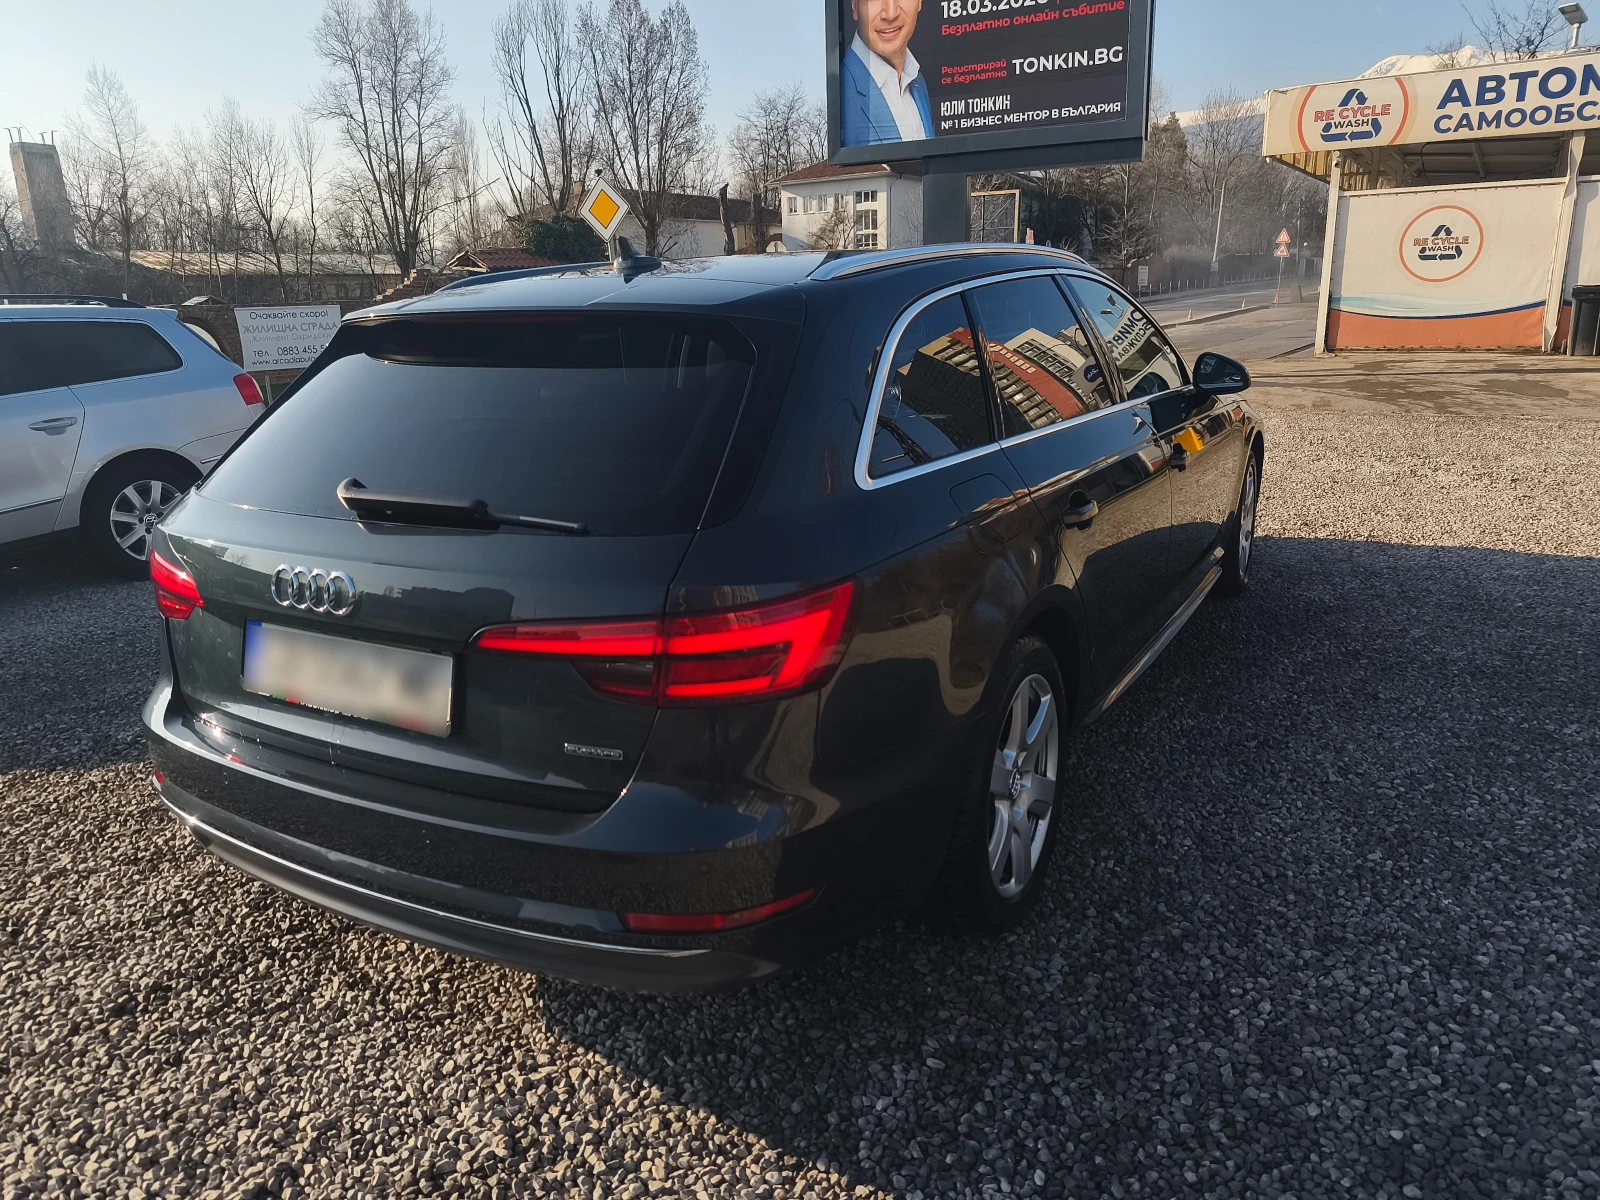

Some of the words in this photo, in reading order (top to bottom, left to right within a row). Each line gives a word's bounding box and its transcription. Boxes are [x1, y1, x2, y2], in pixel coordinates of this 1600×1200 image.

[941, 18, 1011, 36] Безплатно
[1013, 8, 1059, 25] онлайн
[1062, 0, 1125, 18] събитие
[941, 59, 1007, 75] Регистрирай
[1012, 46, 1123, 75] TONKIN.BG
[941, 76, 952, 85] се
[954, 70, 1007, 84] безплатно
[940, 100, 965, 117] ЮЛИ
[967, 95, 1011, 114] ТОНКИН
[1314, 109, 1335, 122] RE
[1339, 104, 1391, 120] CYCLE
[961, 114, 1002, 128] БИЗНЕС
[1004, 109, 1050, 124] МЕНТОР
[1052, 107, 1059, 119] В
[1061, 102, 1121, 118] БЪЛГАРИЯ
[1433, 100, 1600, 134] САМООБС
[1334, 118, 1370, 129] WASH
[1413, 237, 1429, 246] RE
[1431, 236, 1470, 246] CYCLE
[250, 311, 298, 320] Очаквайте
[300, 309, 329, 319] скоро!
[242, 323, 299, 334] ЖИЛИЩНА
[301, 322, 338, 332] СГРАДА
[277, 346, 300, 356] 0883
[302, 345, 318, 354] 455
